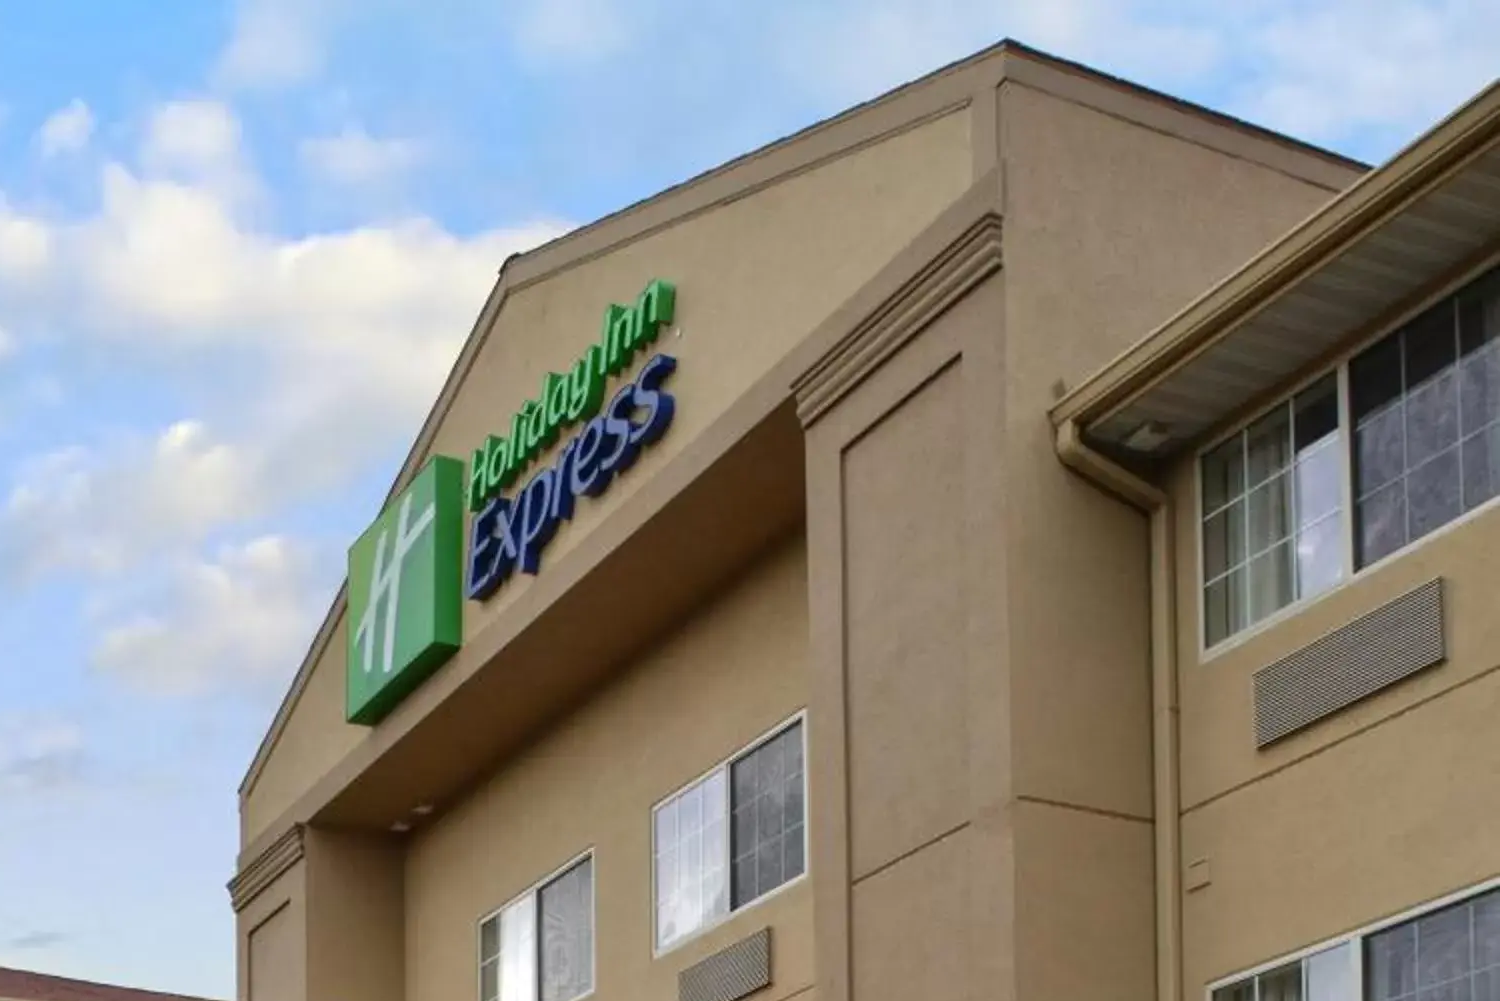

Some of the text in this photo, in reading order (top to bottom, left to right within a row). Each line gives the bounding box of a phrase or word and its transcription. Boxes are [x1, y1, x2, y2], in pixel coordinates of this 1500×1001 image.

[464, 353, 677, 600] Express
[467, 280, 675, 512] Holiday Inn
